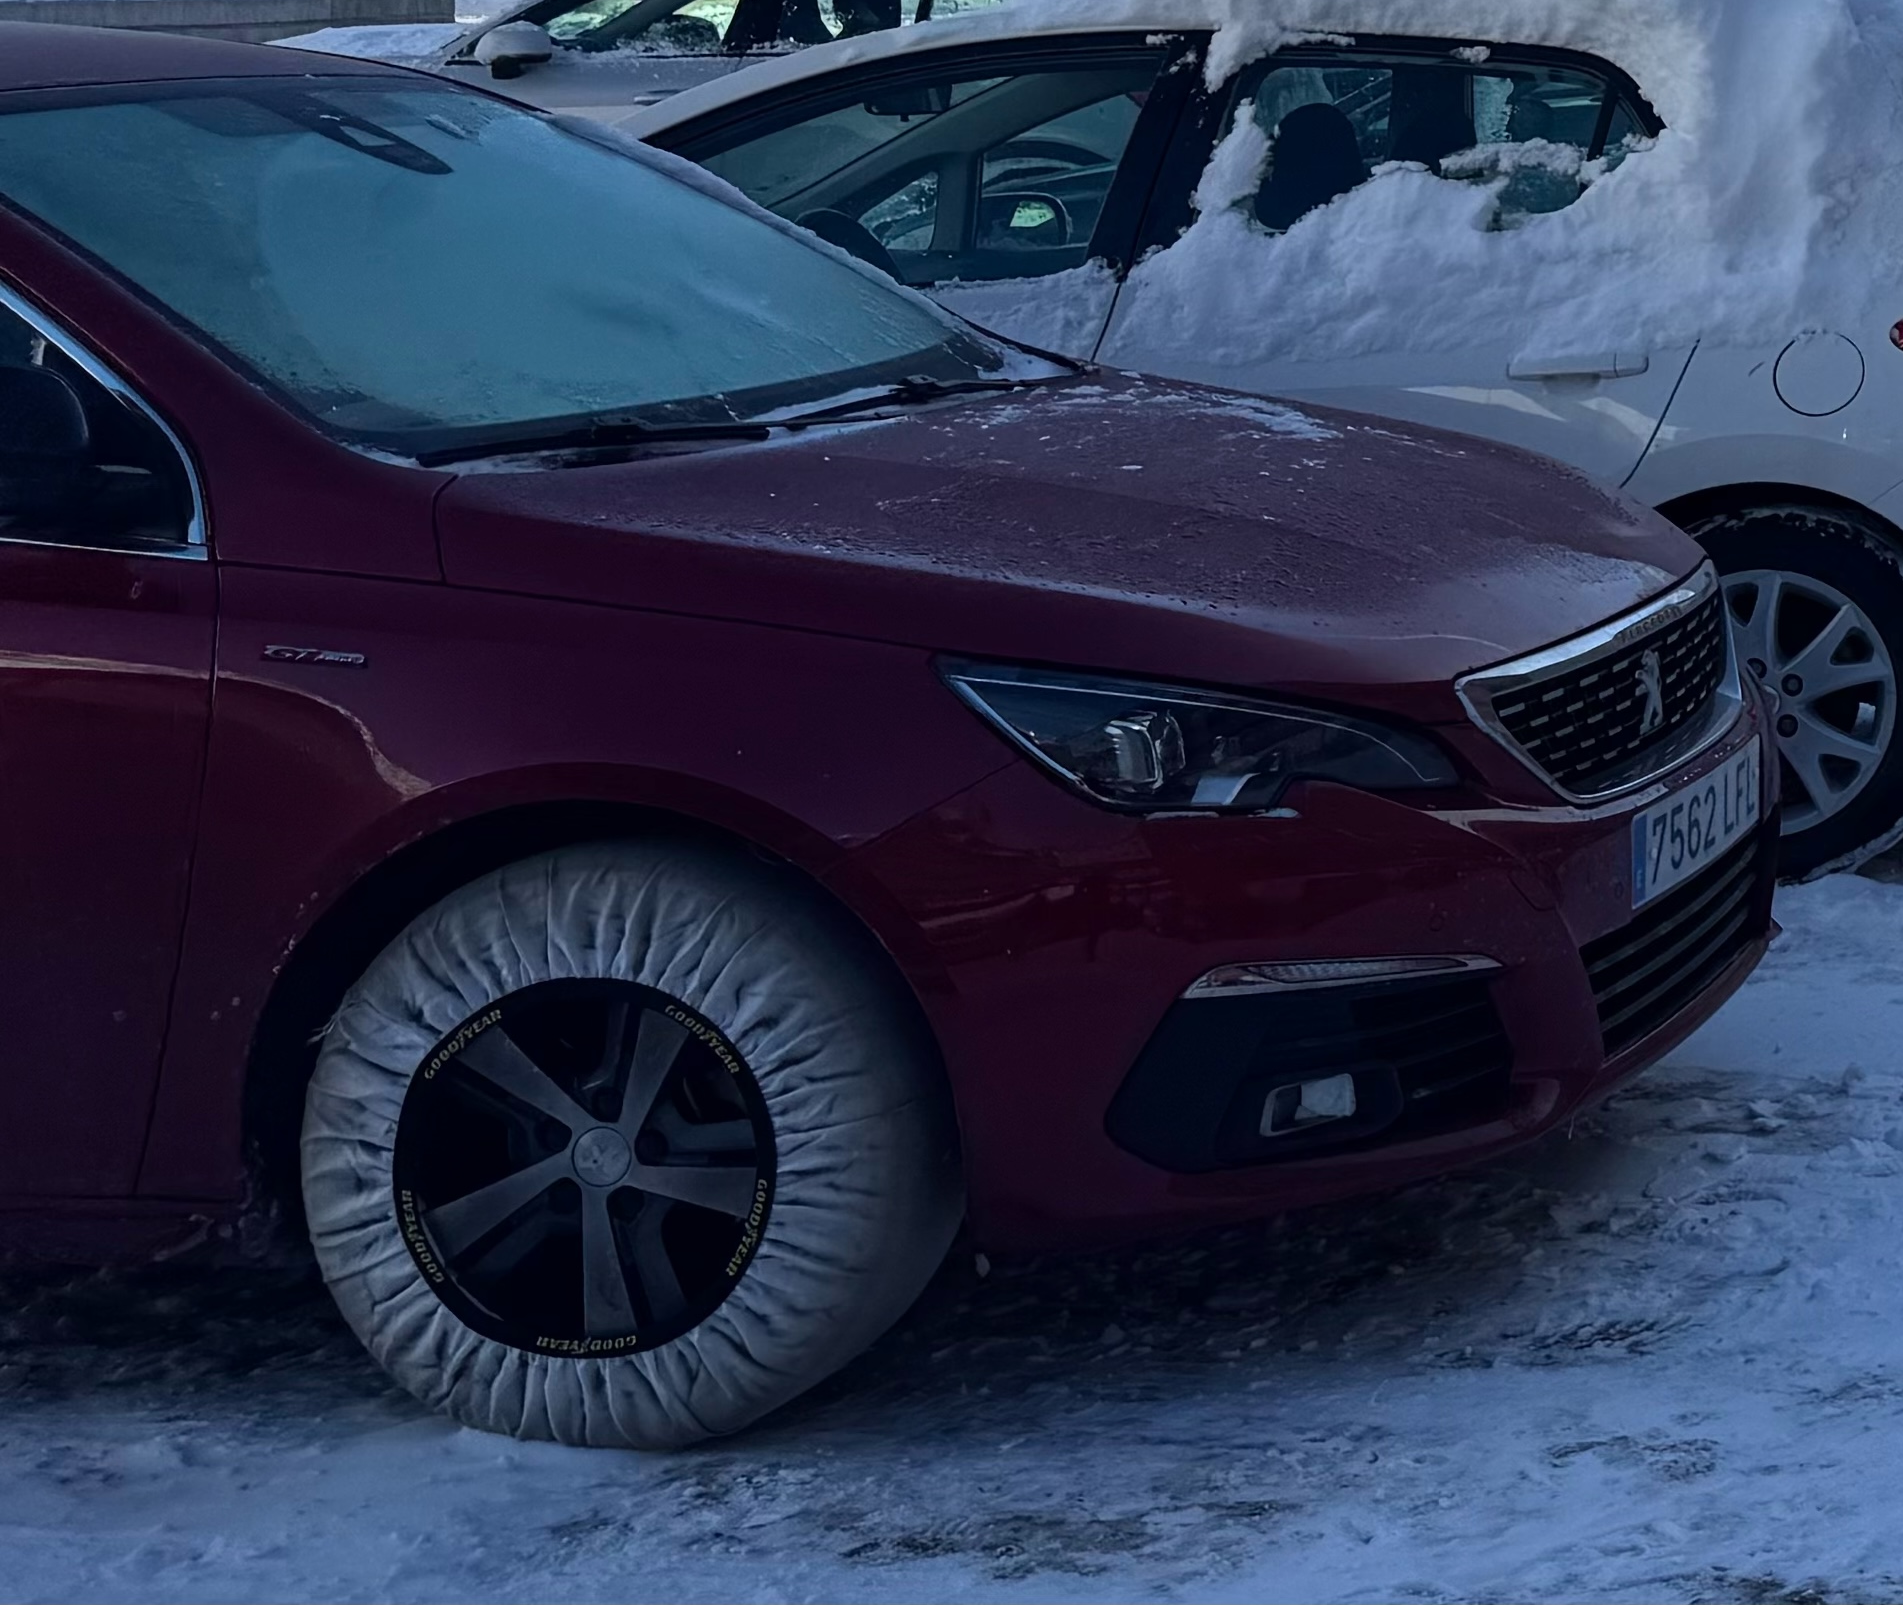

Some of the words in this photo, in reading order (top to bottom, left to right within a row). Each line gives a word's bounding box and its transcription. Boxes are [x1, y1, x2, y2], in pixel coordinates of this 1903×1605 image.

[1651, 787, 1717, 885] 7562
[424, 1009, 502, 1080] GOODYEAR
[664, 1004, 740, 1075] GOODYEAR
[402, 1190, 444, 1284] GOODYEAR
[725, 1179, 767, 1277] GOODYEAR
[537, 1335, 637, 1355] GOODYEAR
